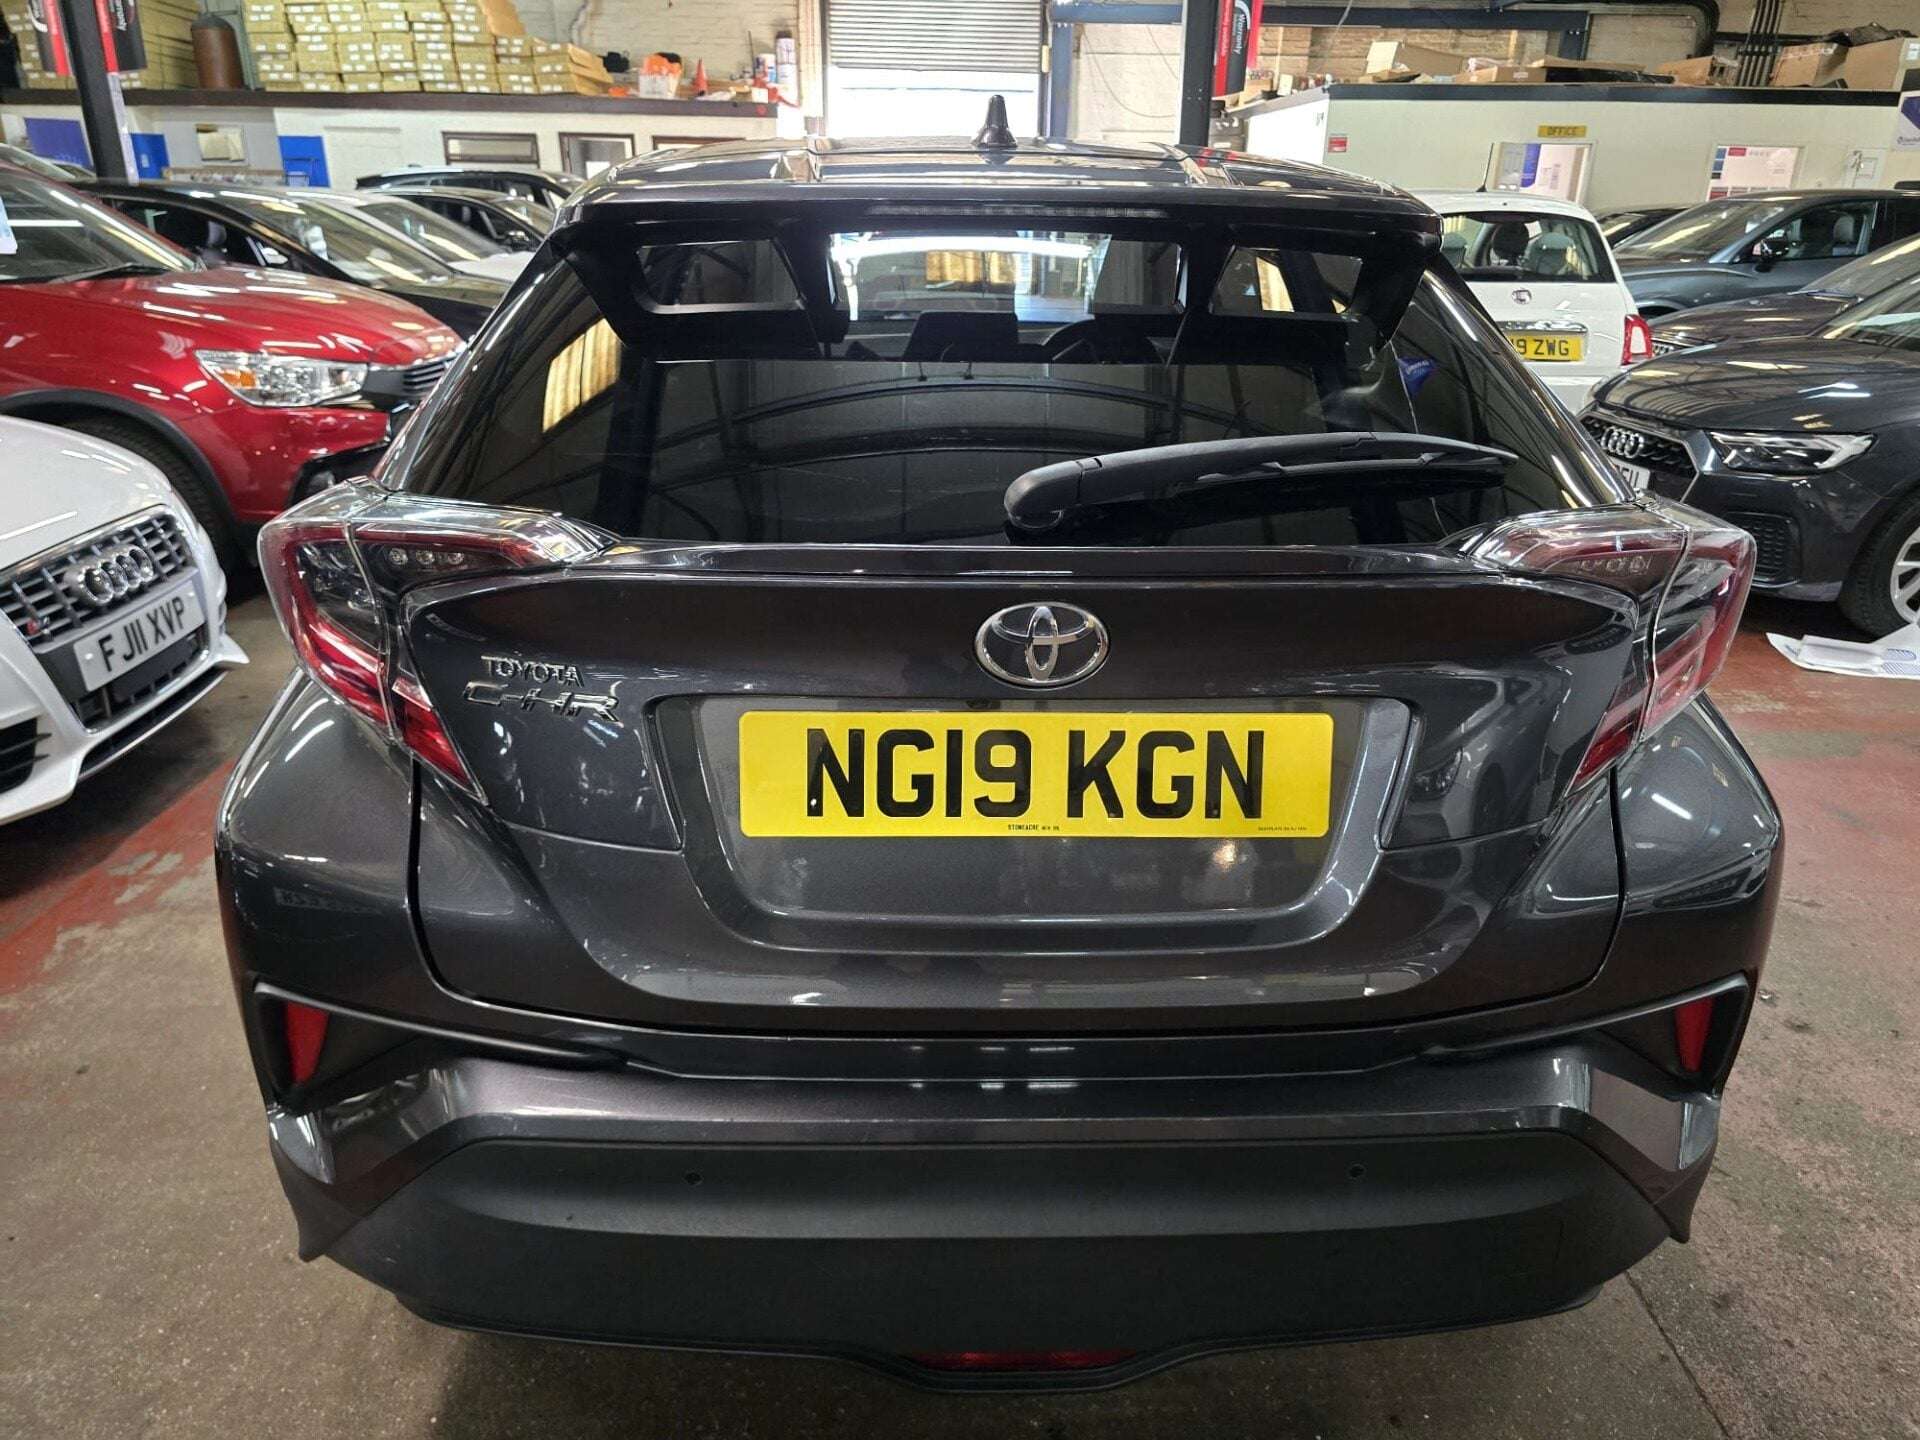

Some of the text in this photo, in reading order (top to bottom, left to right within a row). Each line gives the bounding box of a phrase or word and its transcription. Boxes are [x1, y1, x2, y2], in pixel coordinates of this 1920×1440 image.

[1233, 13, 1246, 54] Warranty
[1547, 126, 1577, 136] OFFICE
[1533, 338, 1570, 356] ZWG
[146, 597, 185, 645] XVP
[481, 655, 584, 687] TOYOTA
[806, 728, 1264, 819] NG19 KGN
